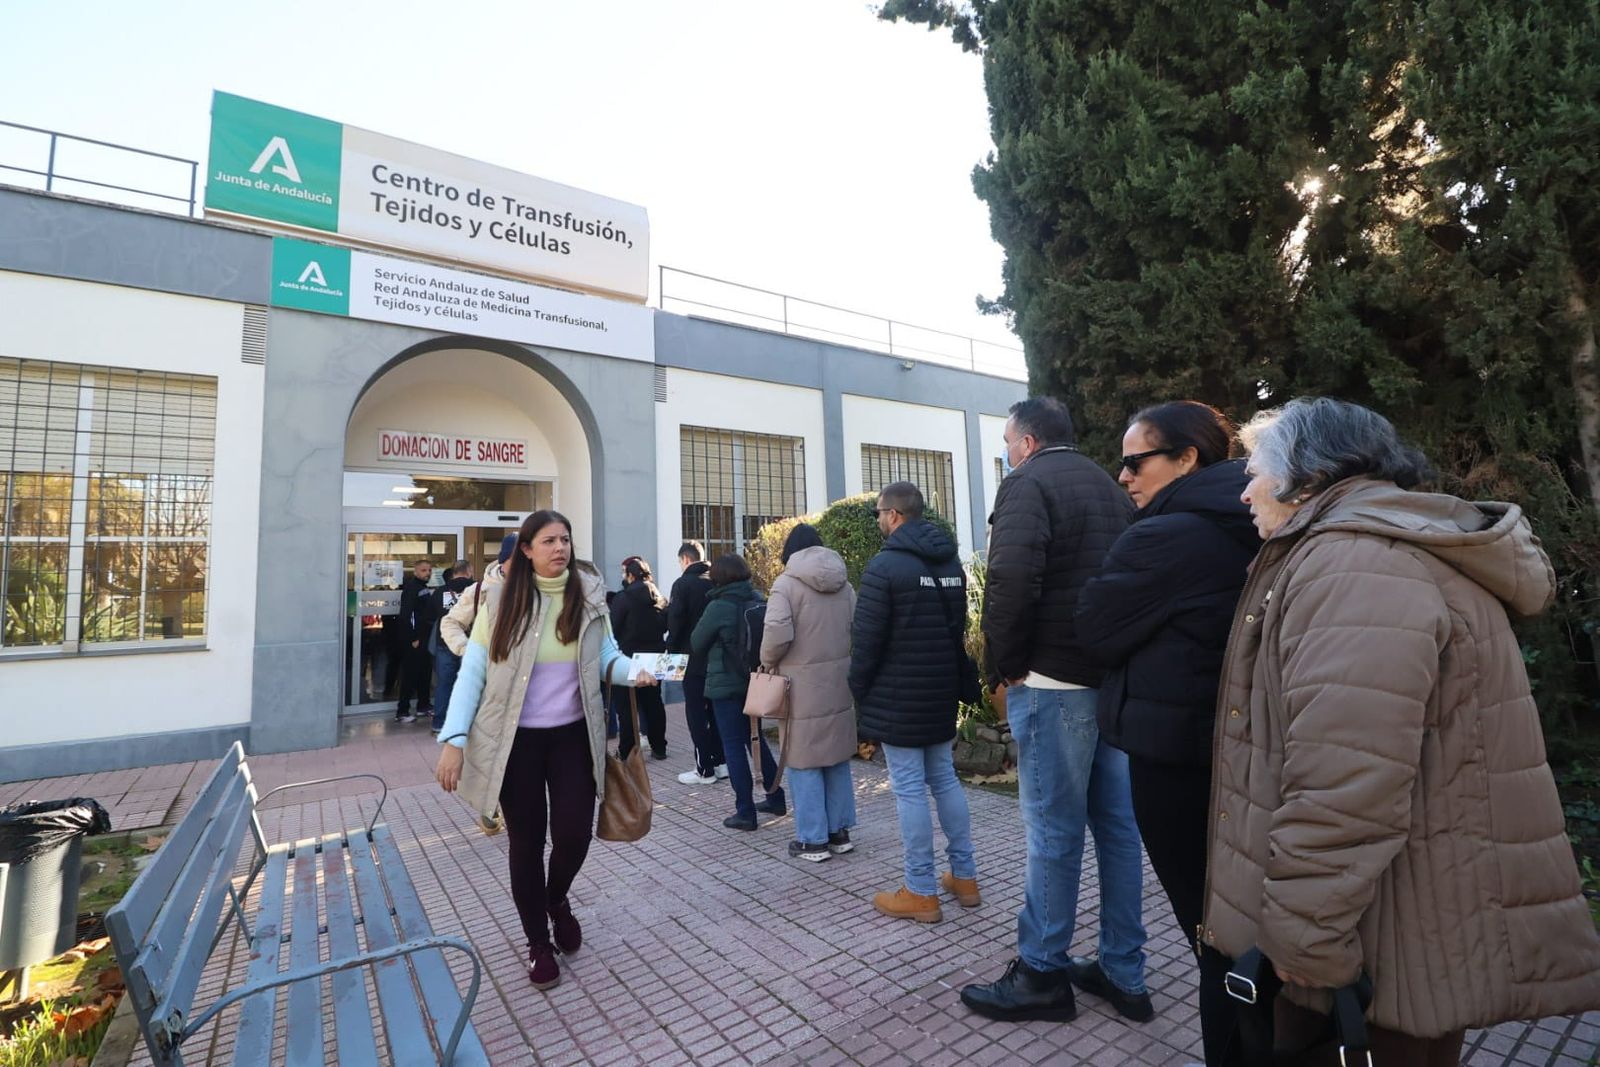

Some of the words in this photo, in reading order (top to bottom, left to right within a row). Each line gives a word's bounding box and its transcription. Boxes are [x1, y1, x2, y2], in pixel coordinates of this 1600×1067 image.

[215, 171, 252, 187] Junta
[254, 179, 271, 191] de
[272, 183, 333, 205] Andalucía
[370, 191, 462, 230] Tejidos
[469, 219, 482, 238] y
[489, 221, 571, 255] Células
[372, 164, 459, 201] Centro
[466, 188, 495, 210] de
[502, 195, 633, 249] Transfusión,
[280, 281, 299, 289] Junta
[310, 286, 343, 297] Andalucía
[374, 268, 426, 286] Servicio
[429, 278, 479, 295] Andaluz
[481, 287, 495, 298] de
[498, 290, 530, 305] Salud
[374, 282, 399, 295] Red
[402, 287, 460, 305] Andaluza
[463, 297, 478, 308] de
[480, 300, 531, 318] Medicina
[533, 310, 608, 332] Transfusional,
[374, 295, 421, 312] Tejidos
[424, 306, 431, 316] y
[434, 306, 479, 322] Células
[382, 434, 450, 459] DONACION
[455, 439, 472, 461] DE
[477, 440, 524, 464] SANGRE
